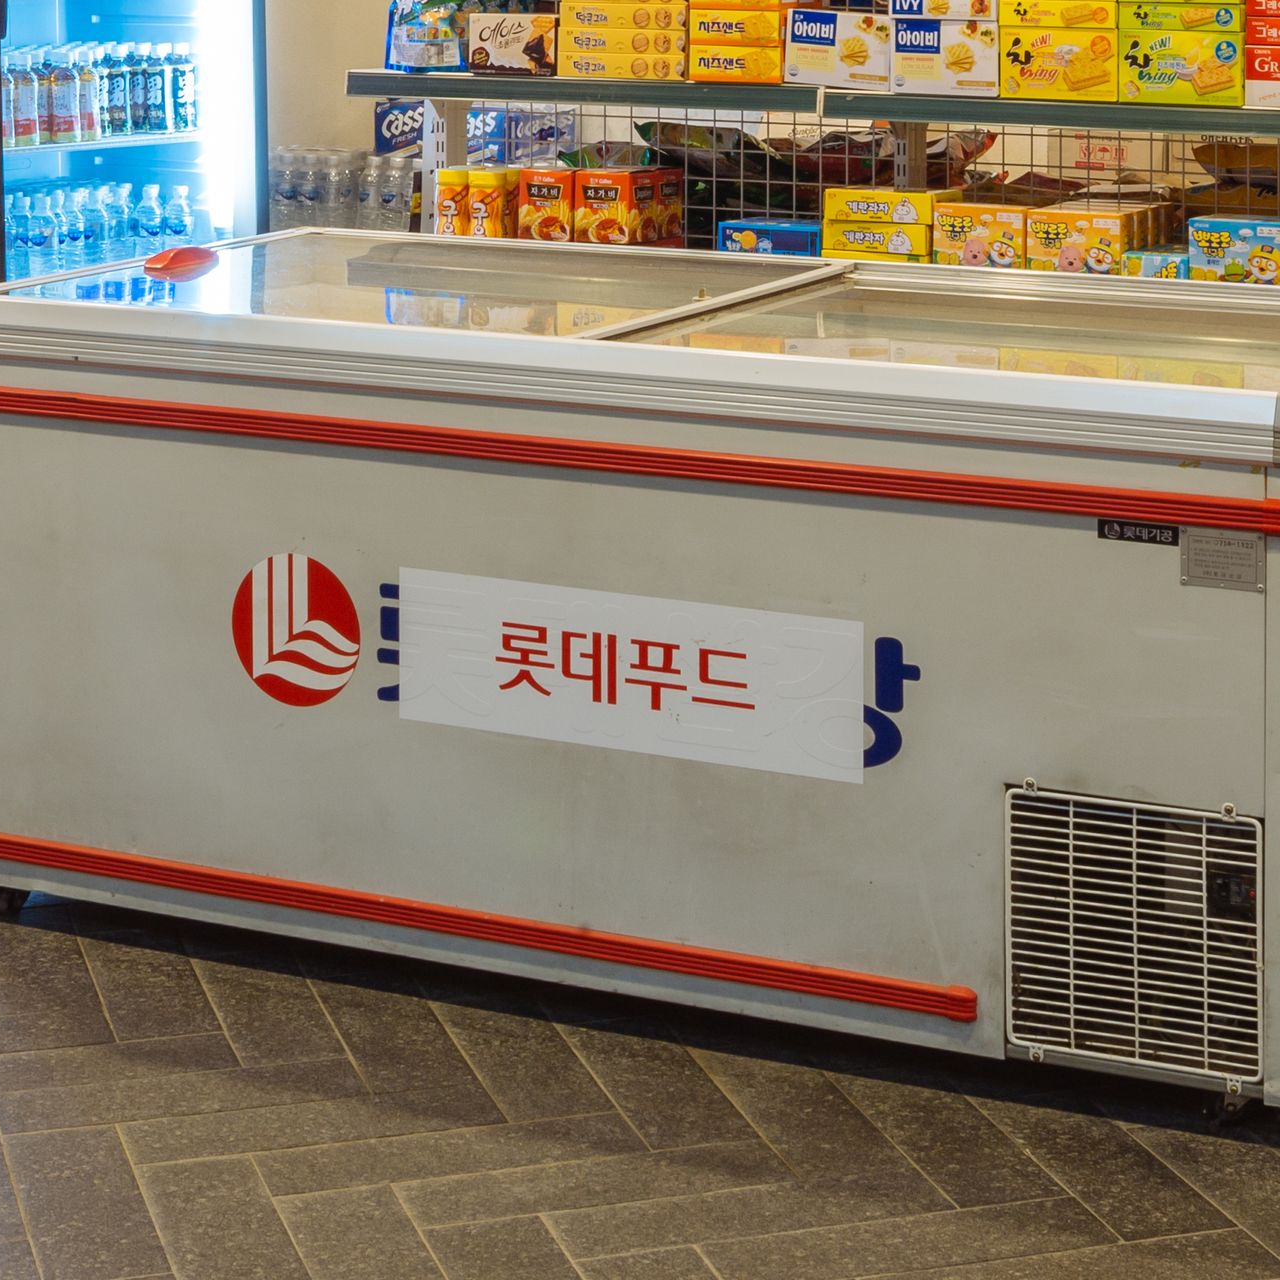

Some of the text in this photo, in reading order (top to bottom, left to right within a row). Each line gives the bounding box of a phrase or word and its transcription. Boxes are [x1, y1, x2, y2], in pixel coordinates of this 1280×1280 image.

[697, 21, 746, 34] 치즈샌드
[794, 21, 834, 40] 아이비
[898, 30, 938, 48] 아이비
[1030, 33, 1052, 50] NEW!
[1149, 35, 1172, 53] NEW!
[697, 56, 746, 69] 치즈샌드
[391, 132, 418, 145] FRESH
[530, 187, 558, 197] 자가비
[586, 188, 616, 199] 자가비
[846, 200, 890, 215] 계란과자
[843, 231, 885, 245] 계란과자
[1122, 524, 1173, 542] 롯데기공
[494, 620, 757, 712] 롯데푸드
